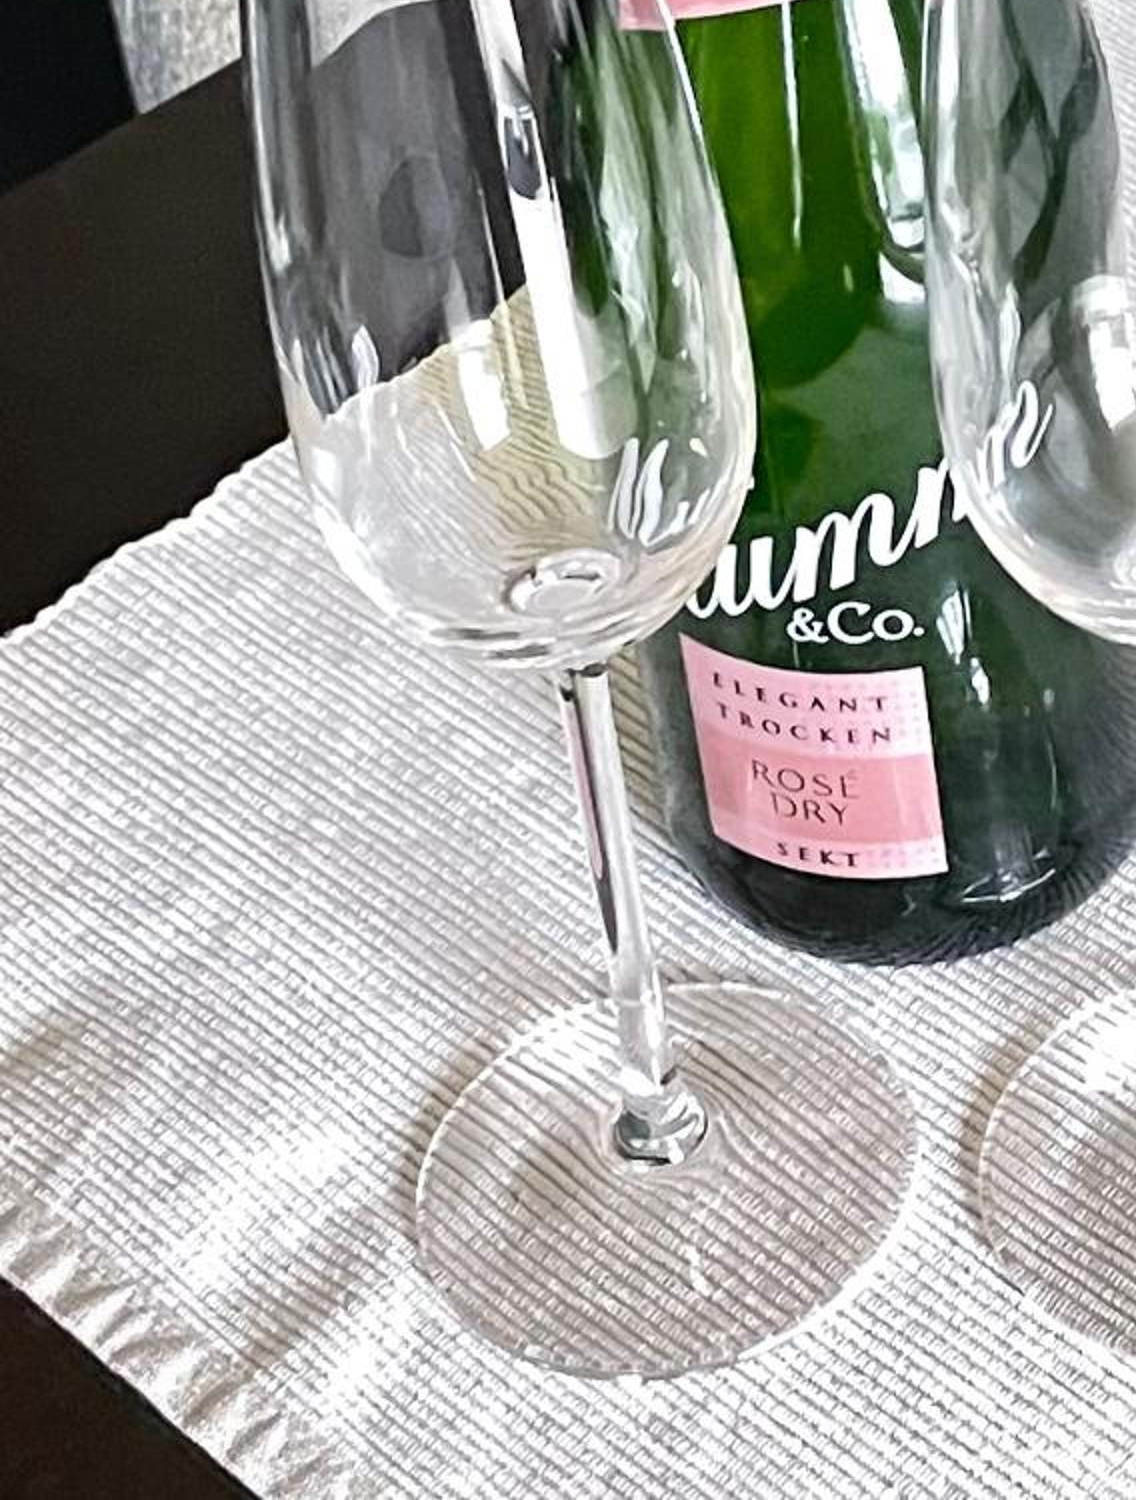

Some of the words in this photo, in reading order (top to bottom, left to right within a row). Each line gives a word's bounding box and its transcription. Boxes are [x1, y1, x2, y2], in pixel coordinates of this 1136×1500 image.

[786, 600, 925, 644] &Co.
[713, 671, 888, 712] ELEGANT
[716, 702, 891, 743] TROCKEN
[770, 791, 848, 826] DRY
[777, 843, 859, 868] SEKT
